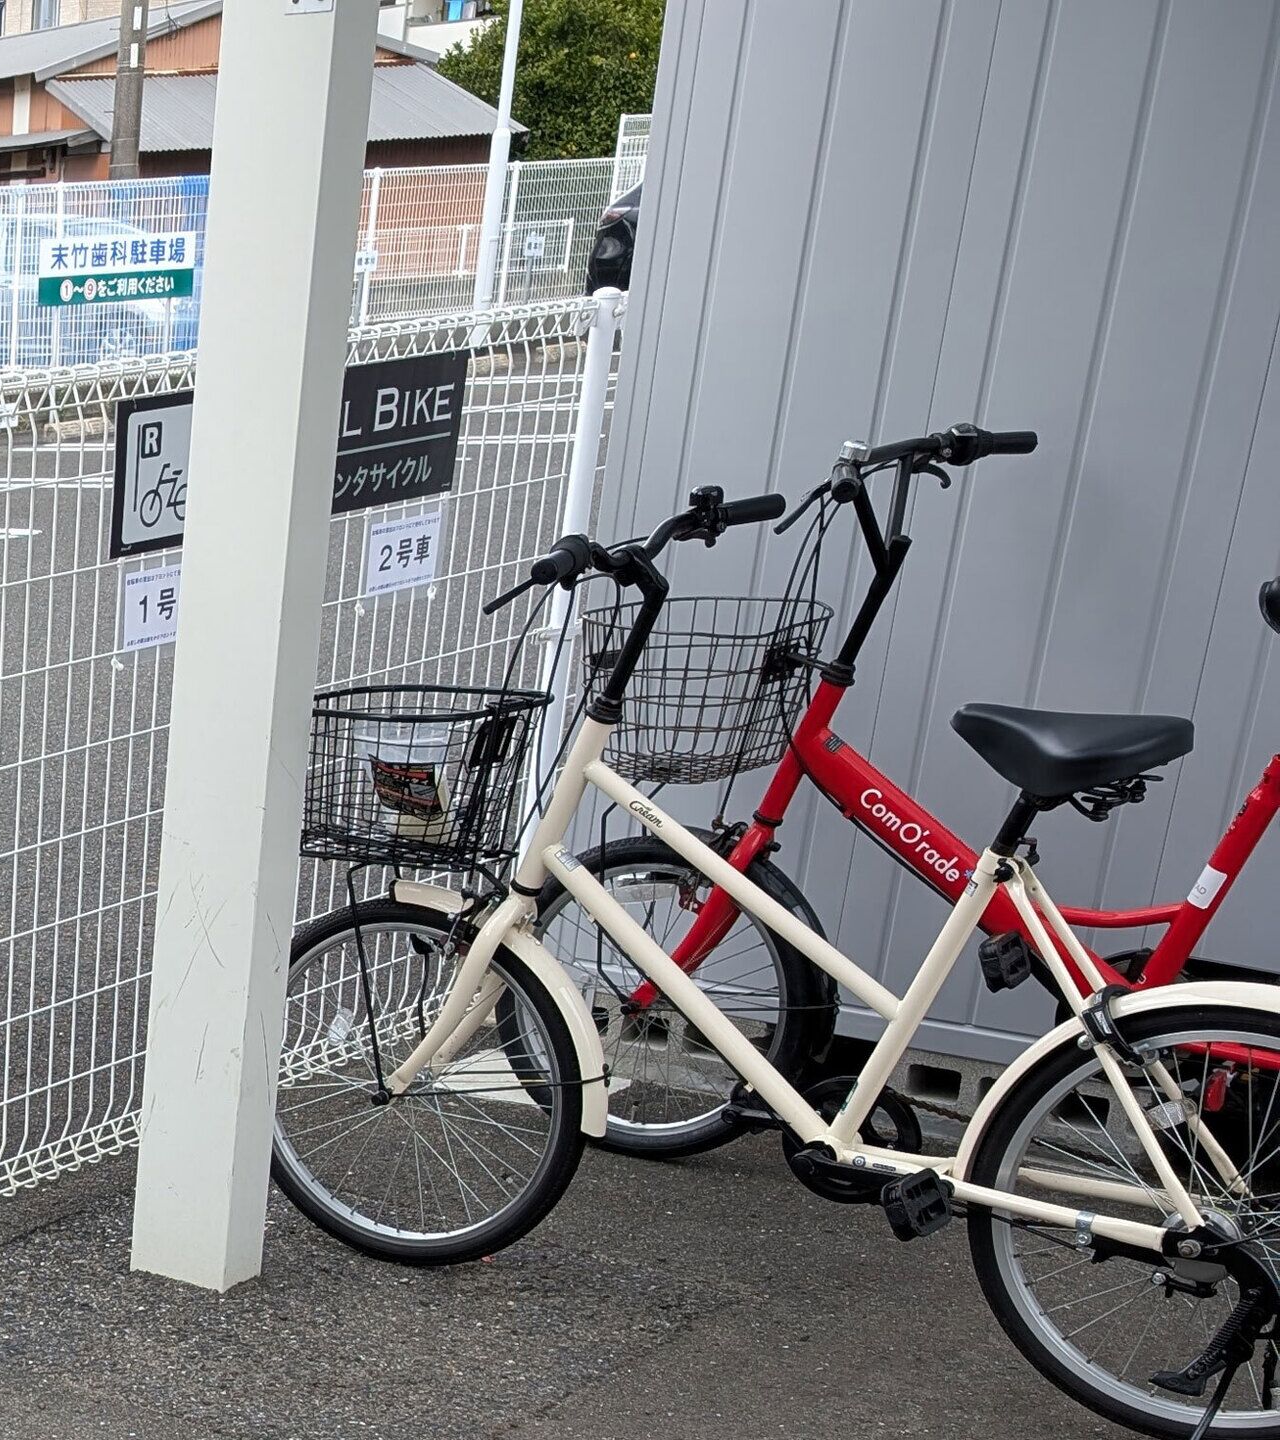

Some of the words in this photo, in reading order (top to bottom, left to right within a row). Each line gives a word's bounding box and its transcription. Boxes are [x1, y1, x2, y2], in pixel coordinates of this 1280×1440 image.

[50, 237, 186, 270] 末竹歯科駐車場
[338, 400, 362, 438] L
[372, 382, 455, 432] BIKE
[144, 426, 160, 455] R
[334, 455, 432, 499] ンタサイクル
[378, 534, 432, 572] 2号車
[139, 587, 177, 624] 1号
[629, 800, 663, 829] Cream
